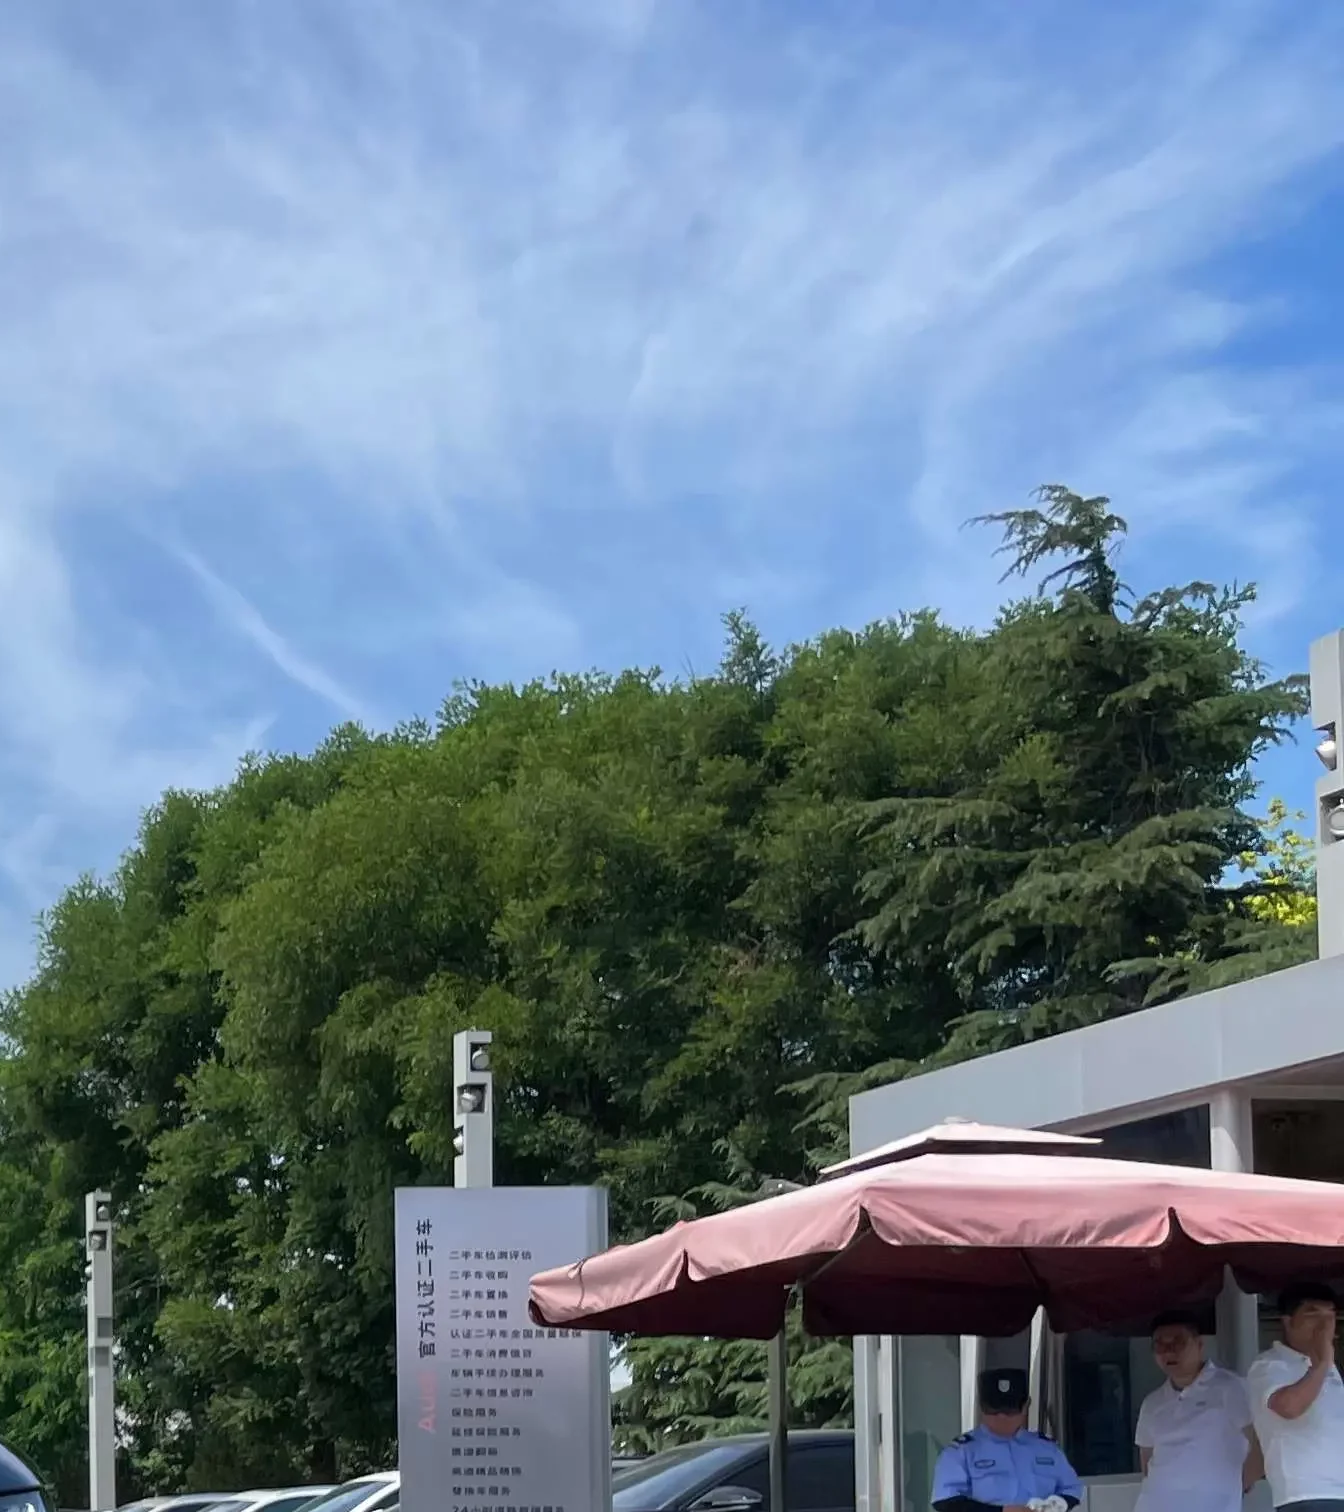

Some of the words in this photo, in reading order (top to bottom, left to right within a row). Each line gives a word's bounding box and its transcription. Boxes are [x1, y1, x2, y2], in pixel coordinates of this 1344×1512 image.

[415, 1218, 436, 1359] 官方认证二手车
